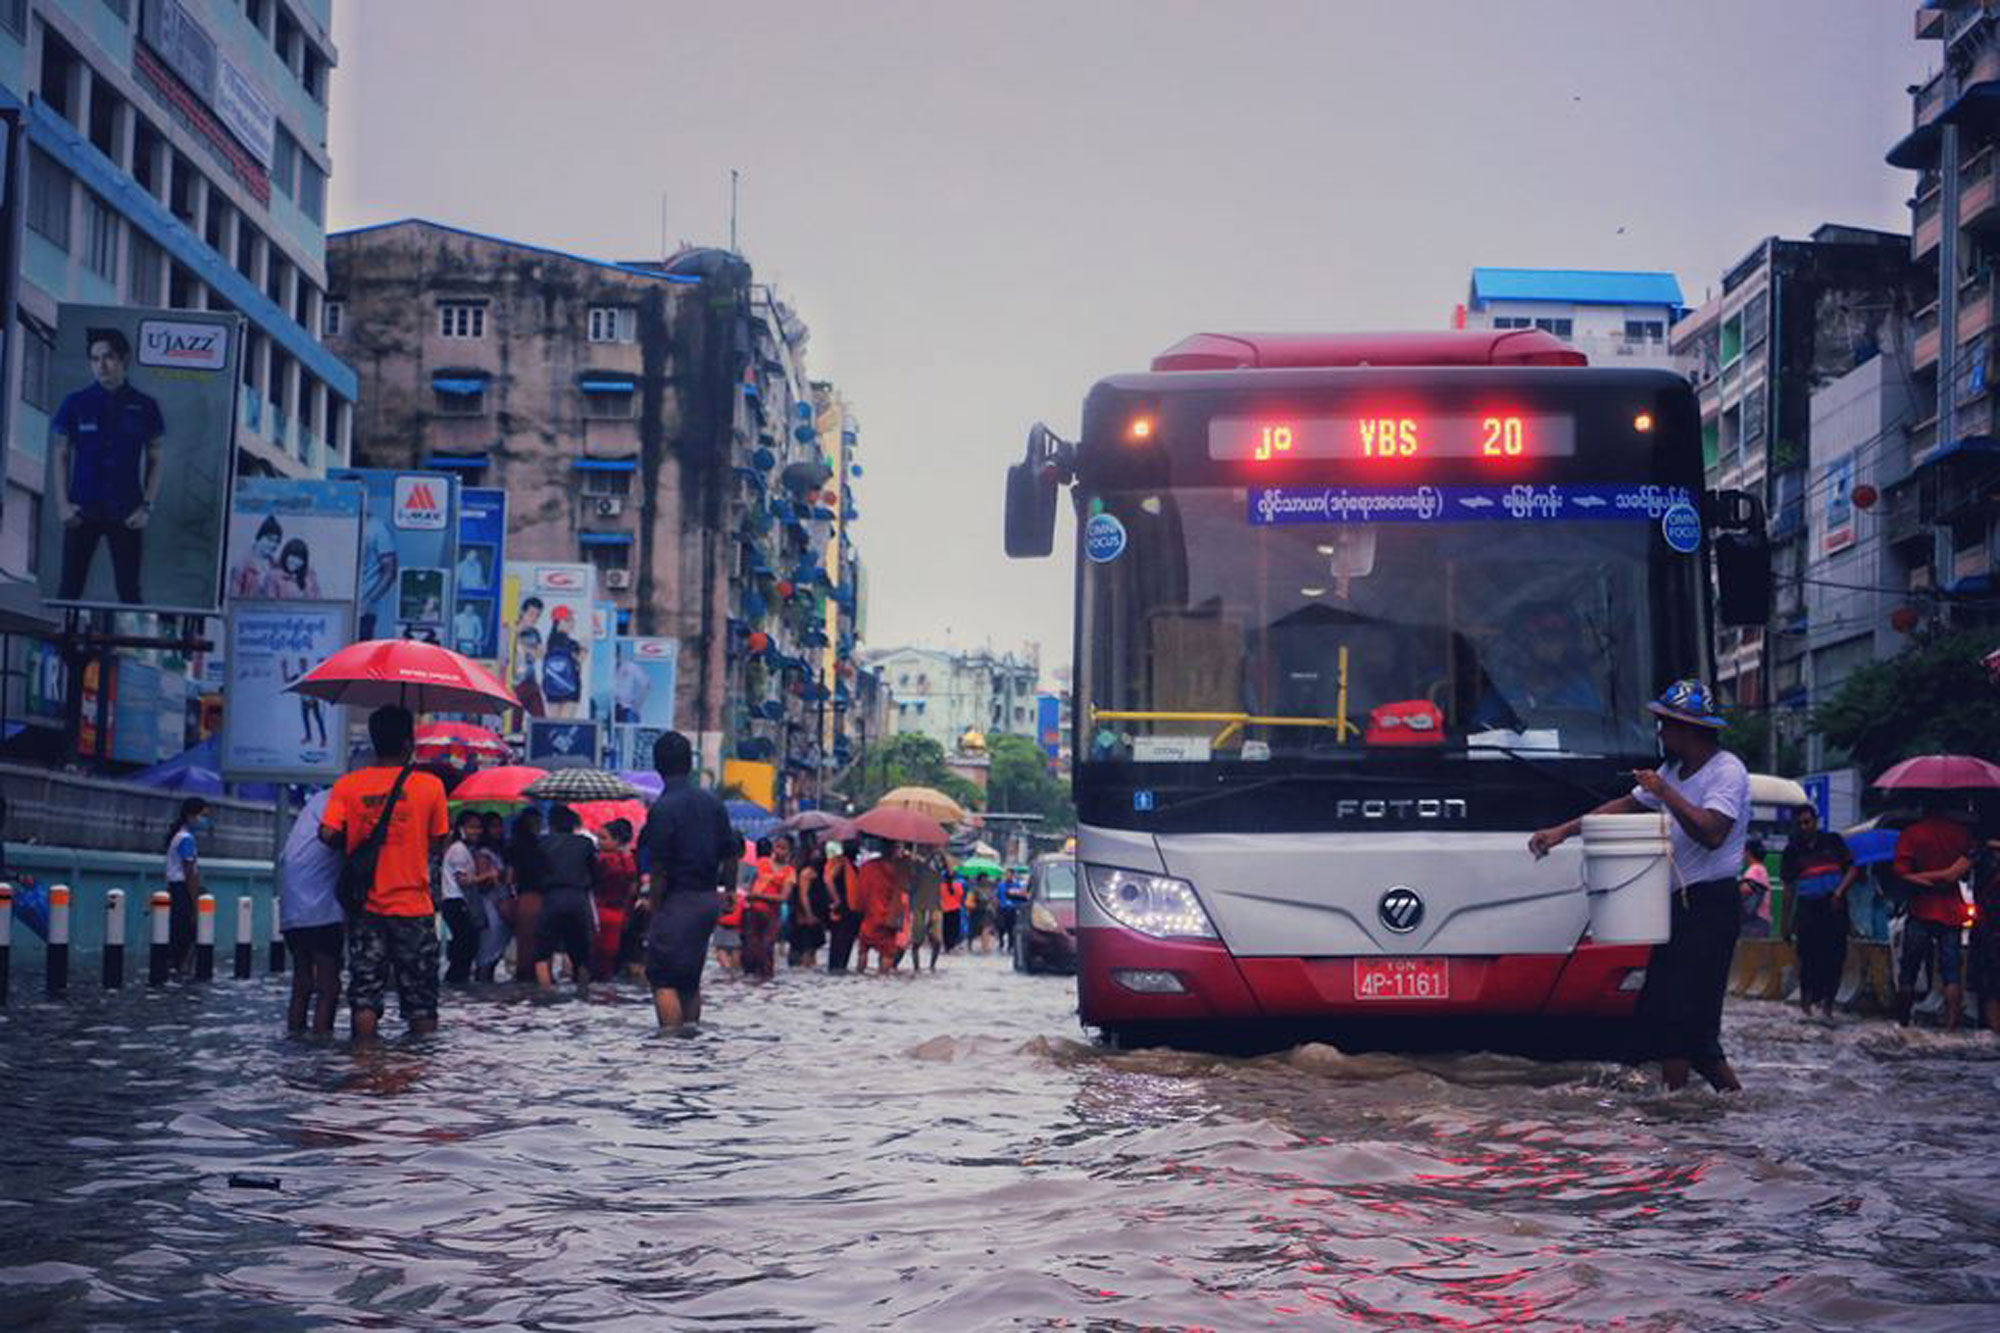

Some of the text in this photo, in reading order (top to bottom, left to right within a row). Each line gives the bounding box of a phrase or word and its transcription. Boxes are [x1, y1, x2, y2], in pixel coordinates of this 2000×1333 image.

[1359, 419, 1417, 457] YBS
[1483, 417, 1523, 456] 20
[1337, 798, 1467, 819] FOTON
[1361, 972, 1440, 996] 4P-1161
